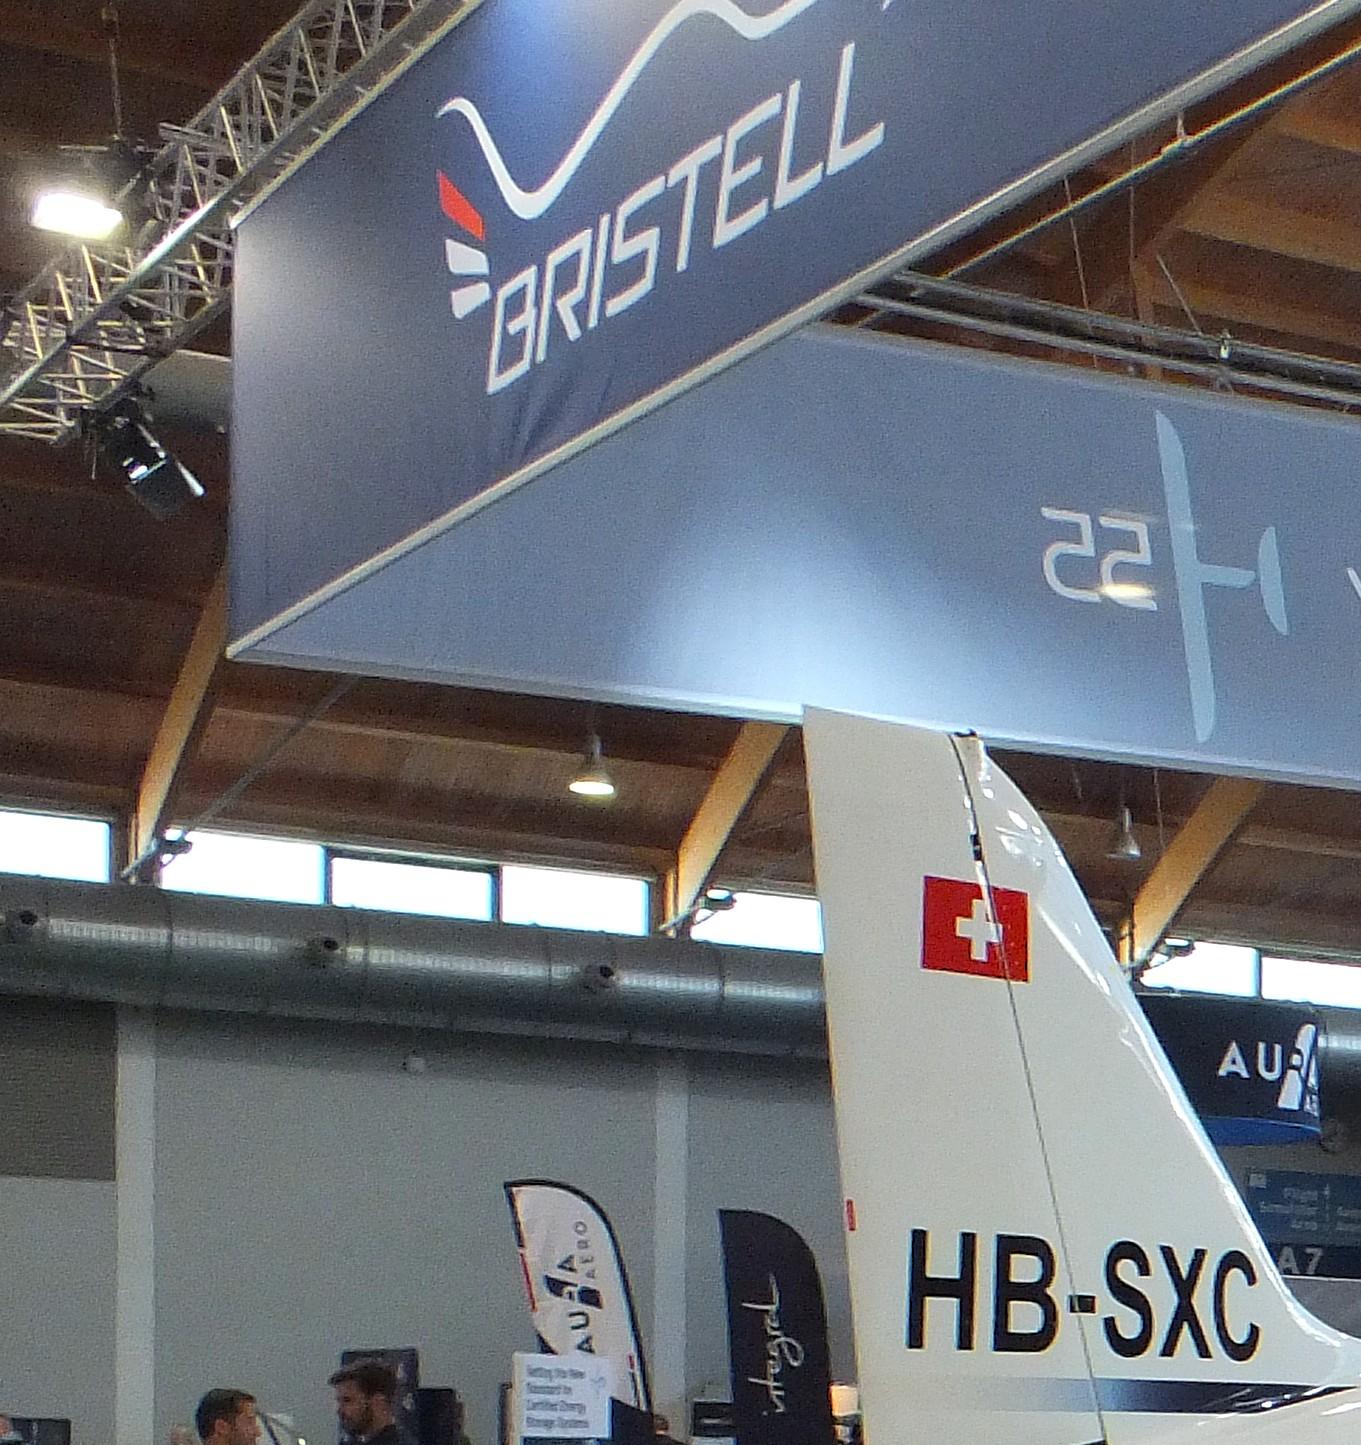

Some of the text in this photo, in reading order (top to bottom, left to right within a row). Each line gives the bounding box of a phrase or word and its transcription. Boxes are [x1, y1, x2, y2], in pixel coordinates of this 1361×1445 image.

[487, 42, 884, 394] BRISTELL
[905, 1229, 1261, 1363] HB-SXC
[1278, 1246, 1324, 1275] A7
